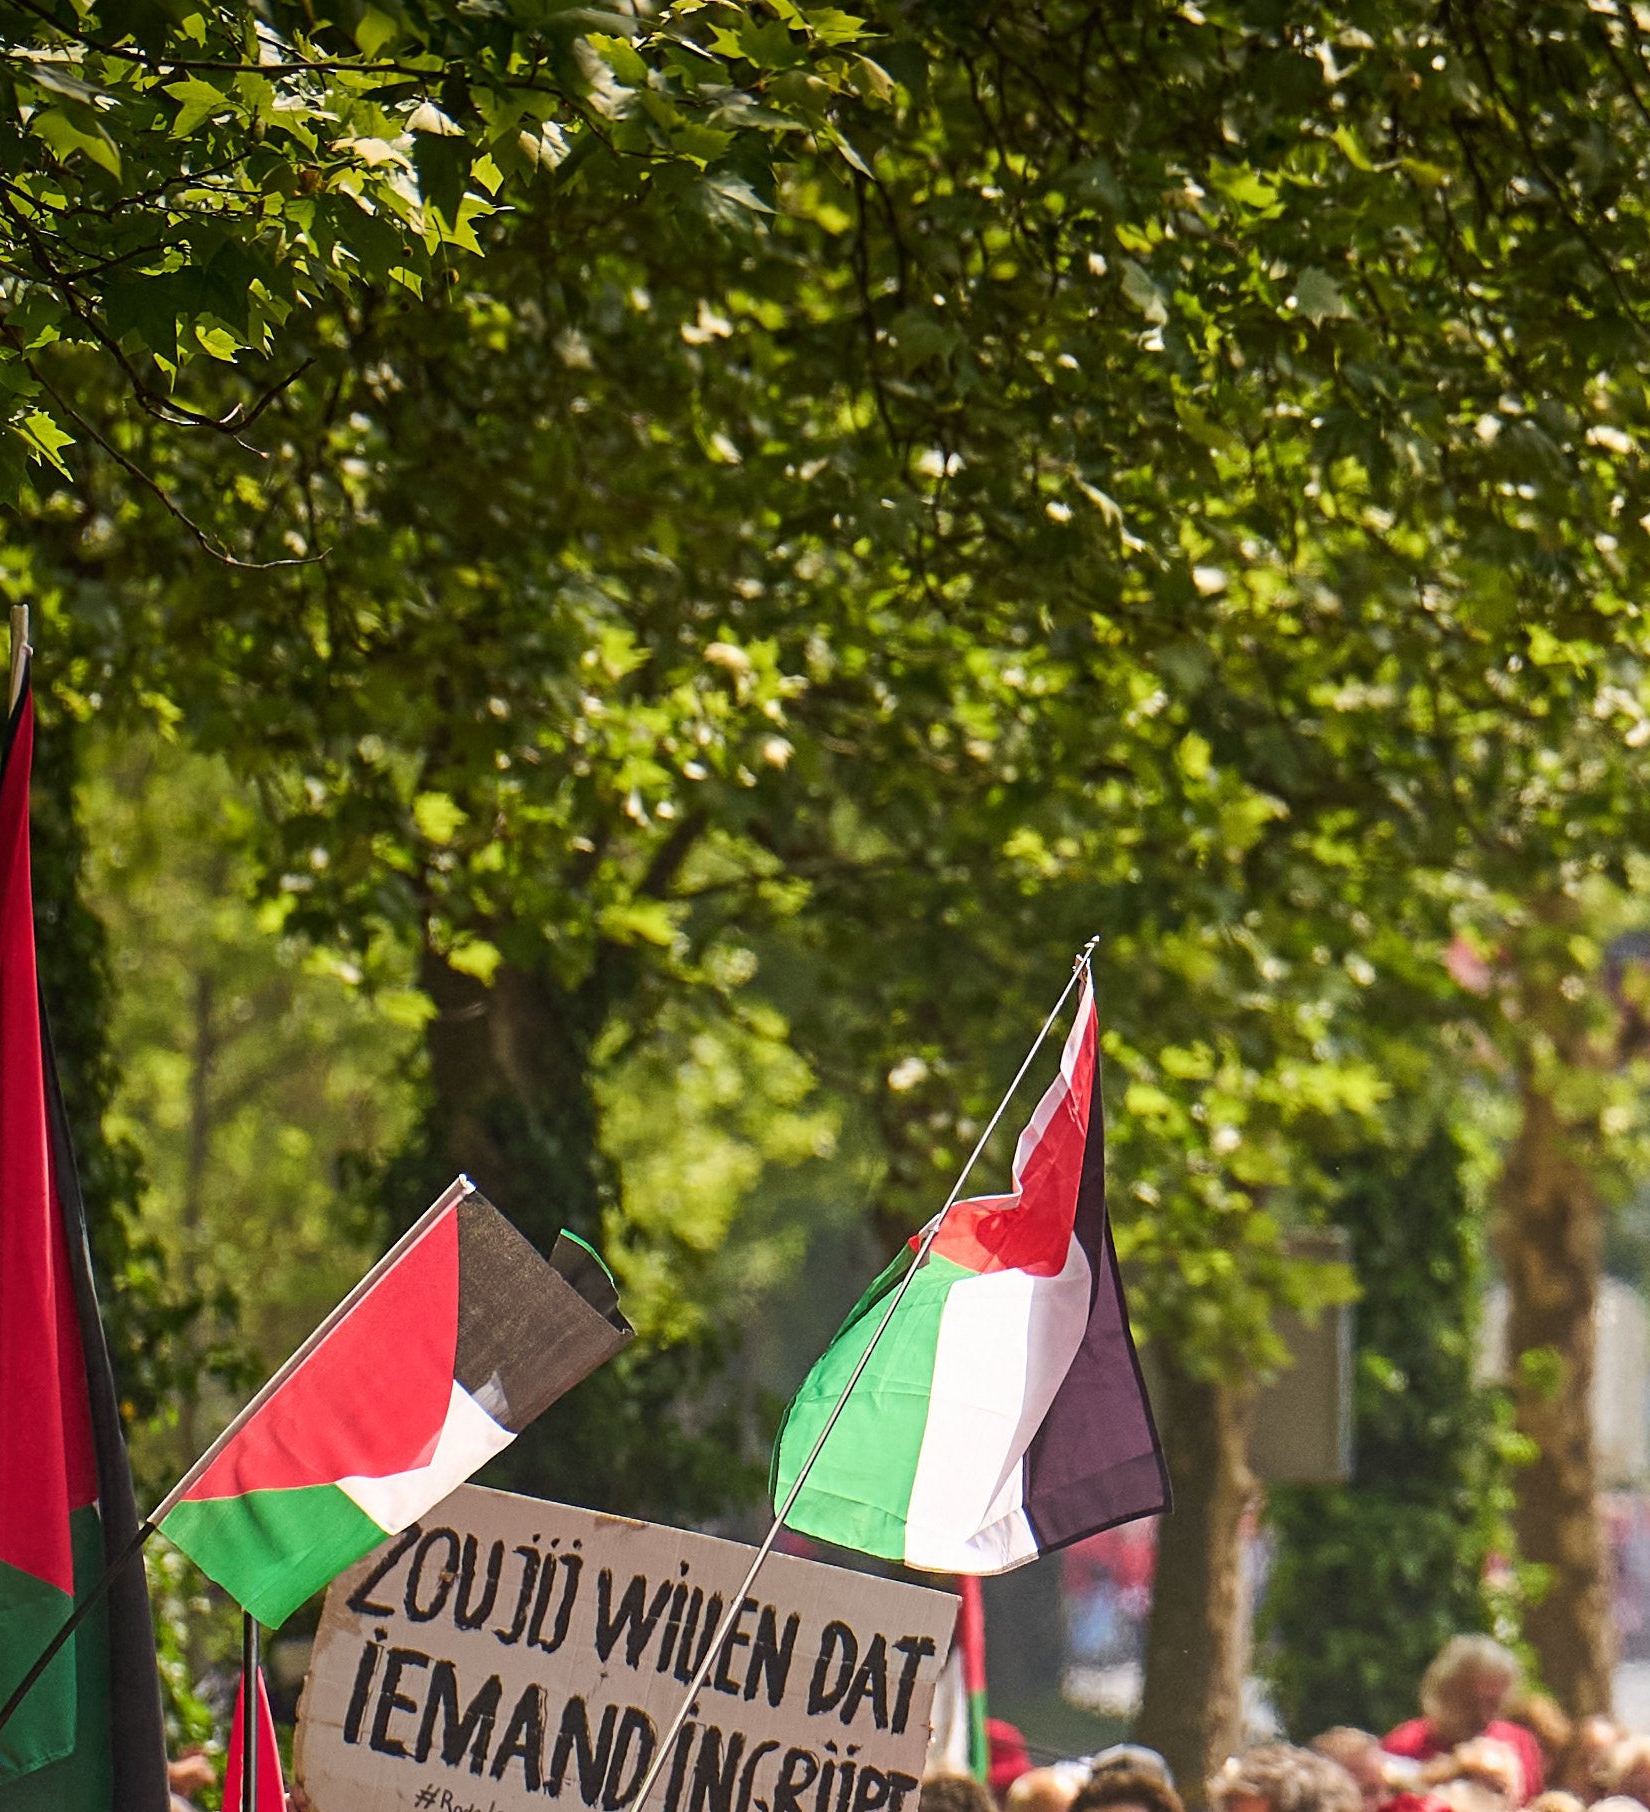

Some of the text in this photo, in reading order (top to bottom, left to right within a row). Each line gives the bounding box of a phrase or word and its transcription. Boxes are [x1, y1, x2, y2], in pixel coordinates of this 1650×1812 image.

[343, 1626, 658, 1811] IEMAND
[347, 1523, 937, 1735] ZOU JIJ WILLEN DAT
